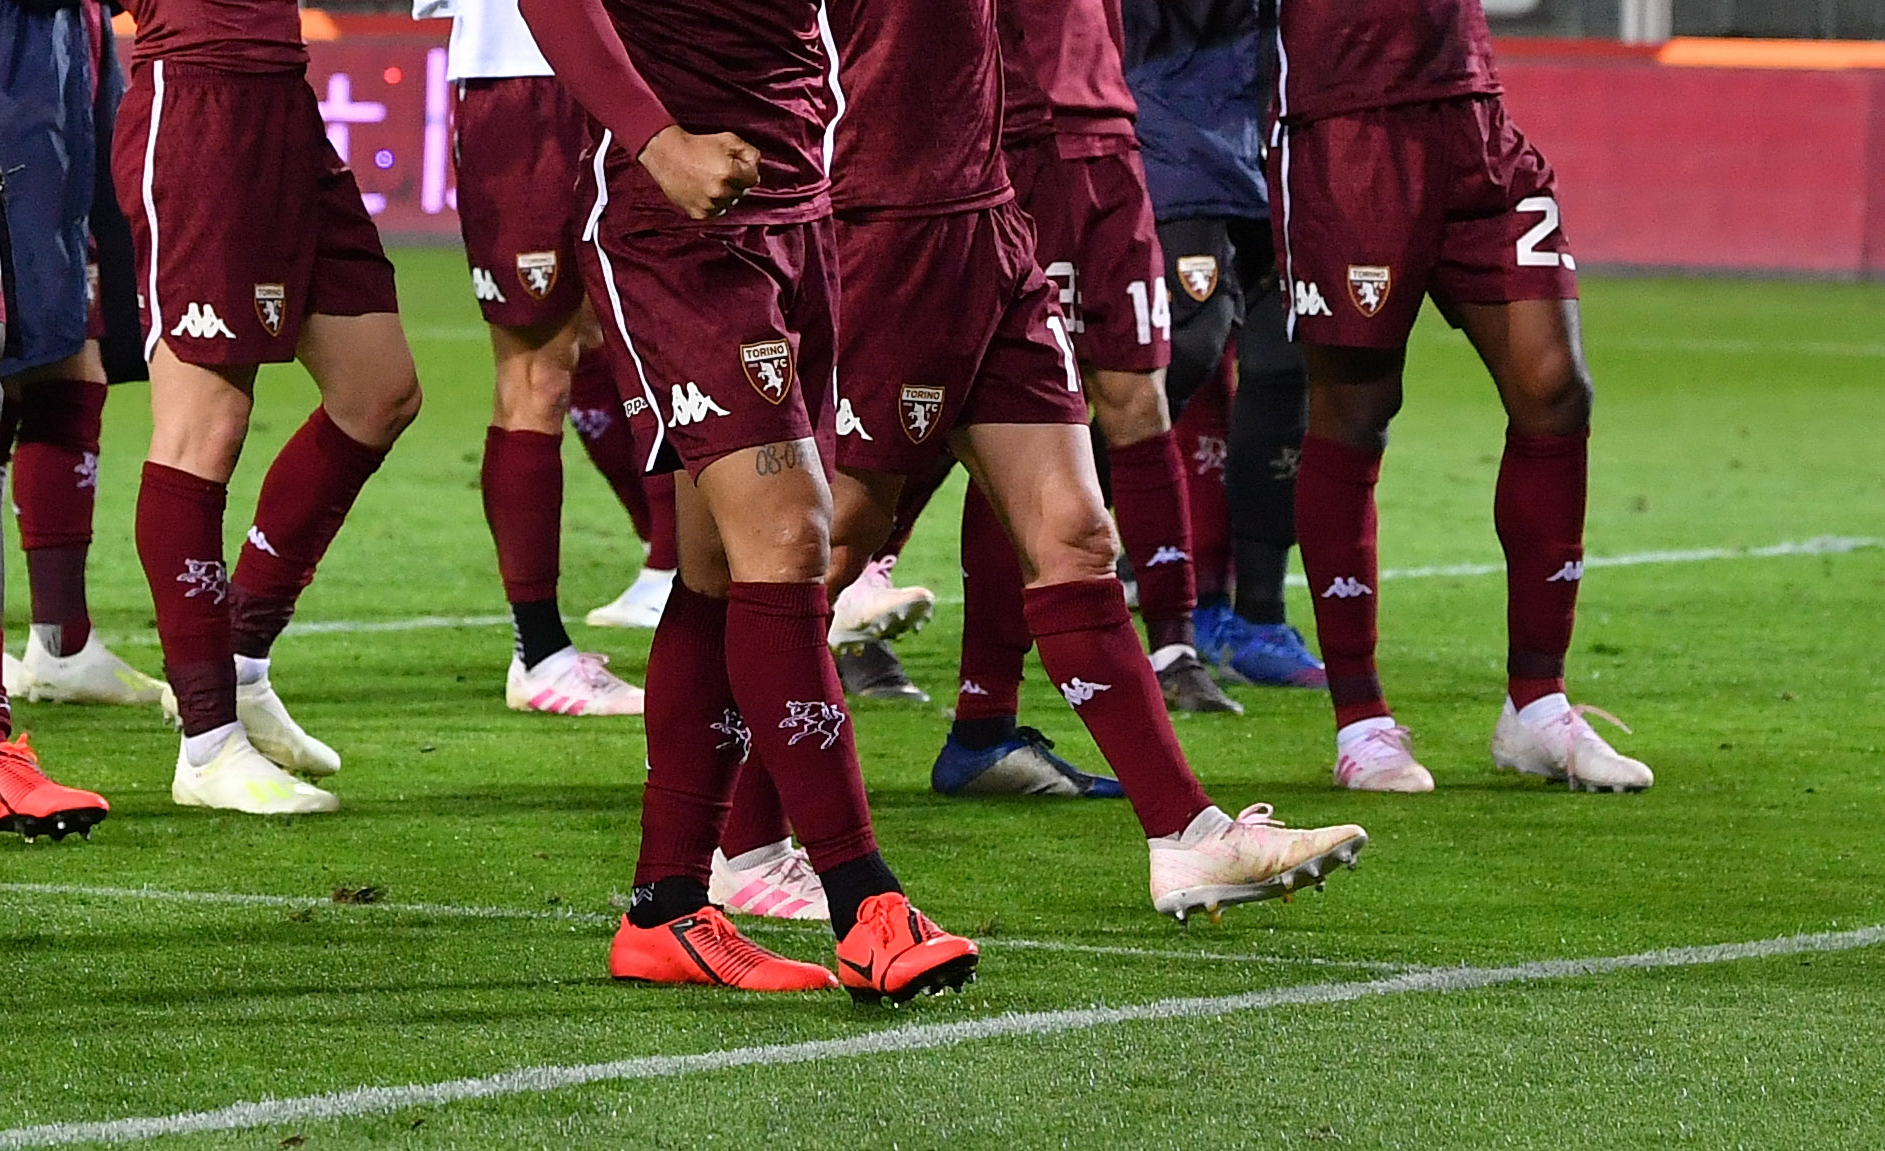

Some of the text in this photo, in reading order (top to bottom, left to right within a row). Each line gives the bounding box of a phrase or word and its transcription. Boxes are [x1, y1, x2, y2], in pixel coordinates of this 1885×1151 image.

[1126, 276, 1171, 345] 14
[746, 344, 786, 359] TORINO
[773, 358, 788, 369] FC
[905, 388, 941, 400] TORINO
[925, 402, 938, 413] FC
